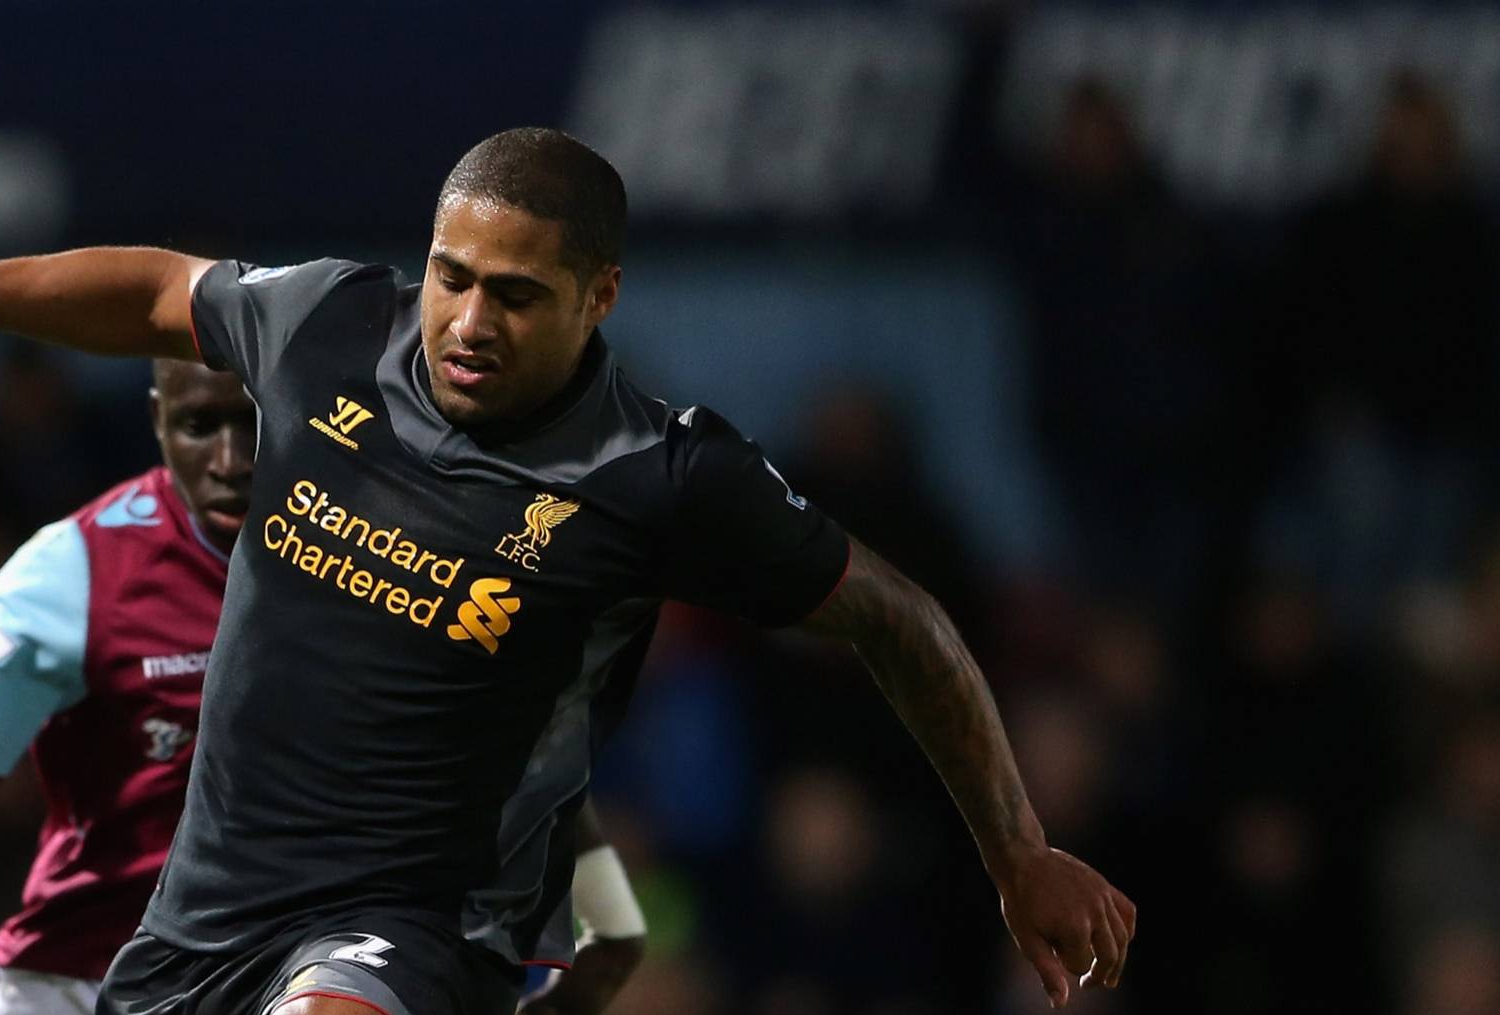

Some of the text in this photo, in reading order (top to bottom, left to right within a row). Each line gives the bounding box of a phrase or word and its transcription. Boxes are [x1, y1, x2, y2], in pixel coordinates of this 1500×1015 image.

[264, 514, 444, 628] Chartered
[286, 479, 465, 588] Standard
[324, 931, 397, 968] 2
